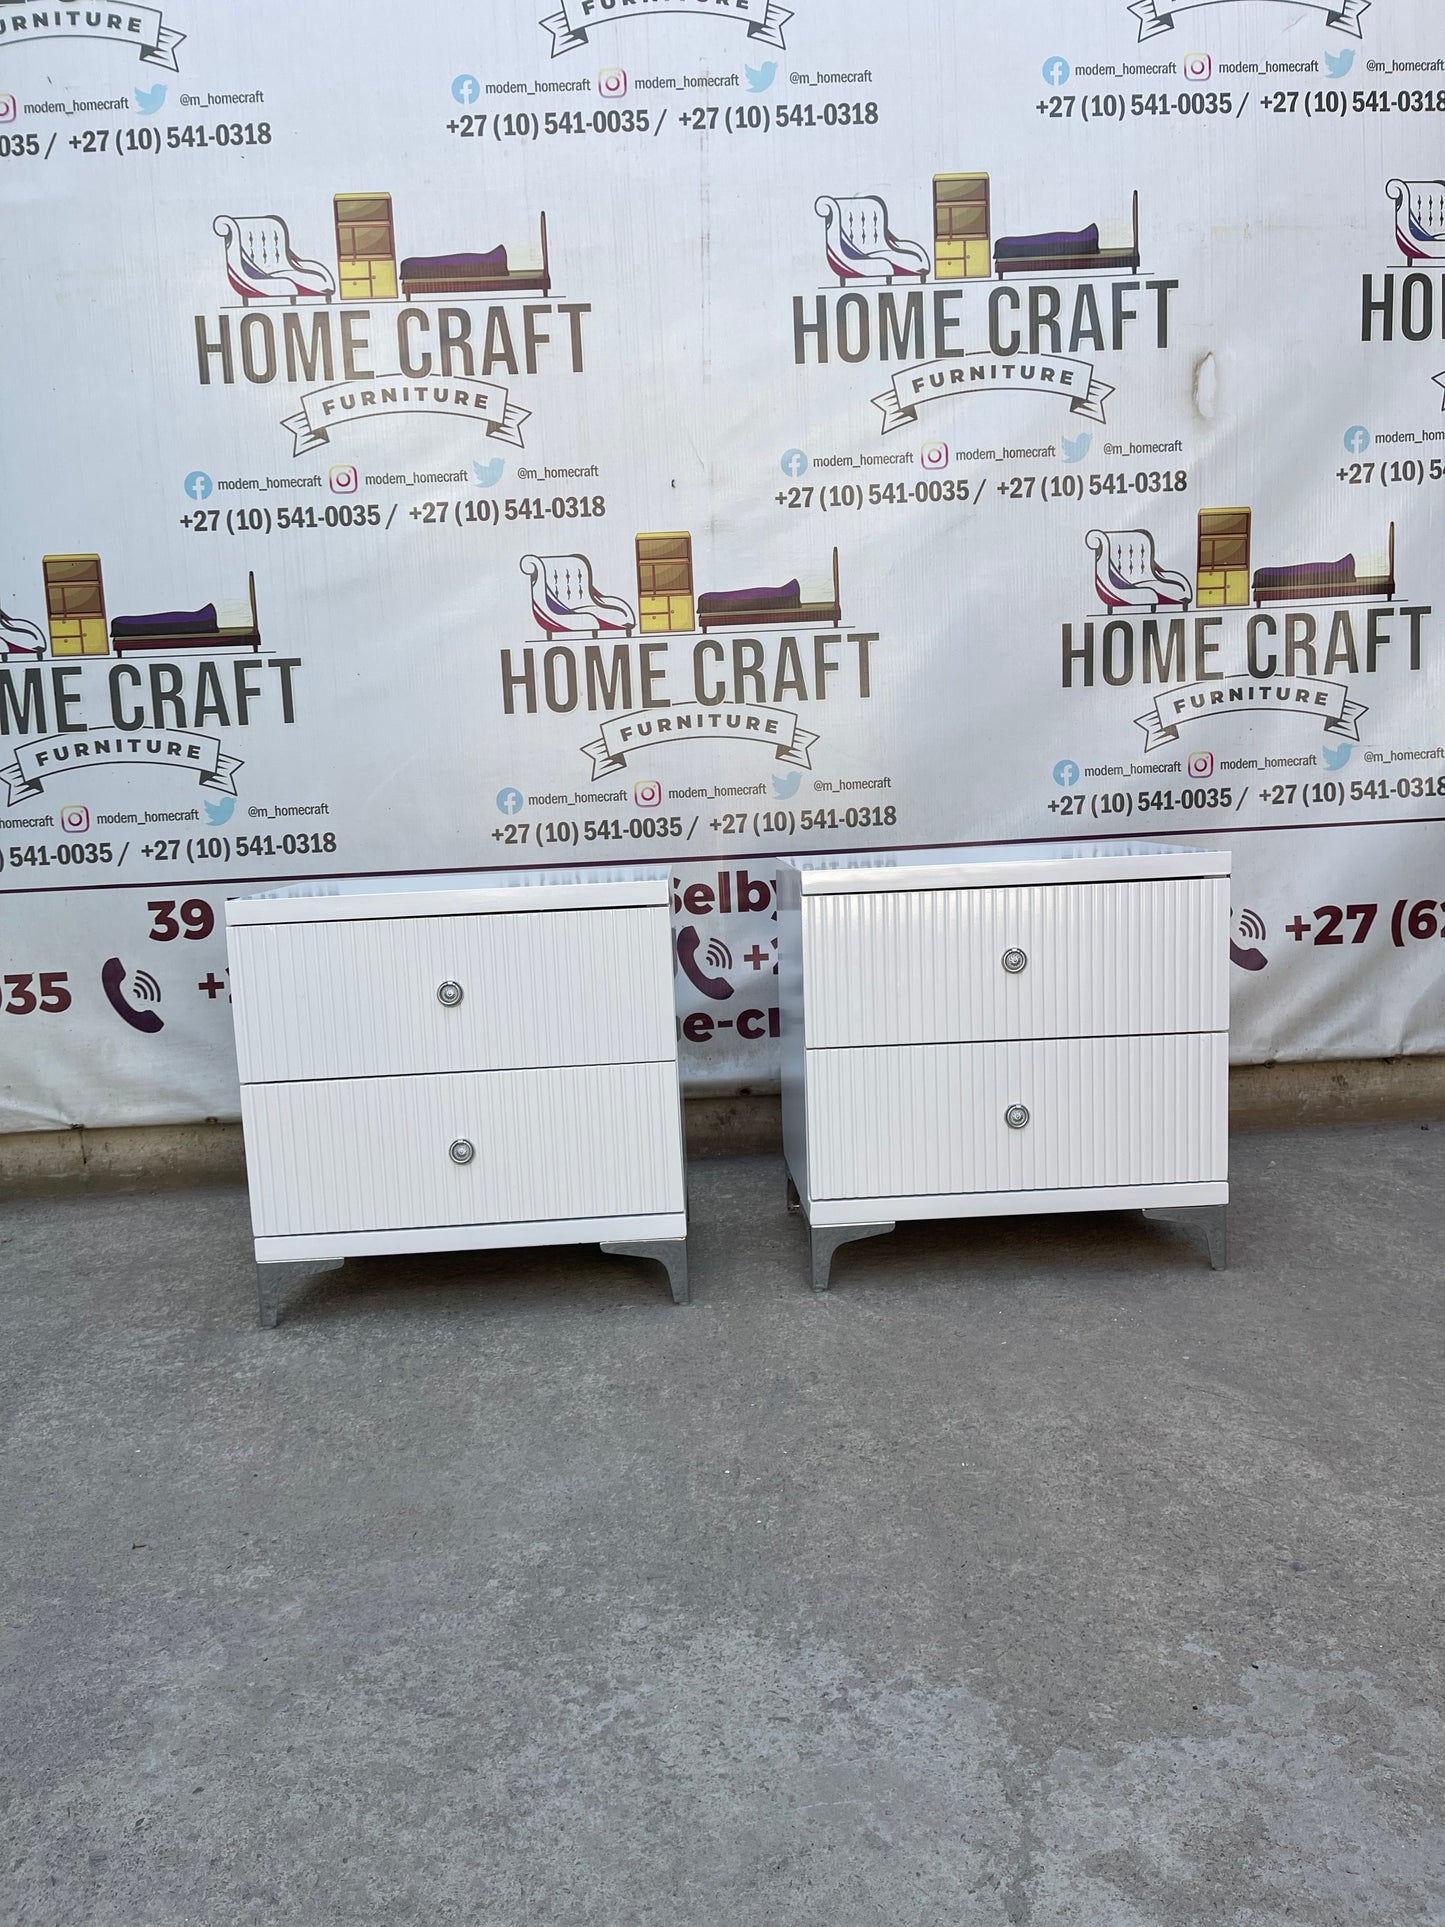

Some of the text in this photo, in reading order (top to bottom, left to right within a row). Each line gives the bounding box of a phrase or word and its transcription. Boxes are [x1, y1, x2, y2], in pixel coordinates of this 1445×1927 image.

[789, 70, 873, 86] @m_homecraft
[1366, 58, 1445, 74] @m_homecraft
[180, 90, 265, 108] @m_homecraft
[1036, 95, 1076, 118] +27
[1081, 94, 1125, 122] (10)
[1130, 92, 1232, 116] 541-0035
[1236, 92, 1250, 118] /
[1260, 91, 1299, 113] +27
[1305, 90, 1347, 117] (10)
[446, 102, 878, 141] +27 (10) 541-0035 / +27 (10) 541-0318
[44, 132, 57, 160] /
[69, 129, 109, 153] +27
[116, 127, 162, 156] (10)
[167, 122, 271, 149] 541-0318
[792, 279, 1179, 365] HOME CRAFT
[1361, 272, 1445, 341] HO
[194, 303, 591, 385] HOME CRAFT
[912, 364, 1075, 393] FURNITURE
[321, 386, 489, 416] FURNITURE
[1103, 439, 1183, 455] @m_homecraft
[517, 465, 599, 481] @m_homecraft
[1336, 458, 1445, 487] +27 (10) 5
[775, 470, 1188, 512] +27 (10) 541-0035 / +27 (10) 541-0318
[180, 495, 606, 535] +27 (10) 541-0035 / +27 (10) 541-0318
[1061, 605, 1432, 688] HOME CRAFT
[500, 632, 880, 715] HOME CRAFT
[108, 657, 302, 731] CRAFT
[1173, 686, 1329, 715] FURNITURE
[619, 714, 780, 742] FURNITURE
[35, 739, 201, 767] FURNITURE
[1363, 747, 1445, 764] @m_homecraft
[813, 777, 891, 793] @m_homecraft
[1047, 795, 1086, 817] +27
[1091, 792, 1133, 818] (10)
[1137, 787, 1233, 811] 541-0035
[1235, 786, 1249, 811] /
[1258, 784, 1298, 805] +27
[1302, 781, 1345, 806] (10)
[247, 803, 330, 820] @m_homecraft
[491, 805, 897, 848] +27 (10) 541-0035 / +27 (10) 541-0318
[9, 842, 113, 867] 541-0035
[117, 841, 130, 867] /
[141, 839, 181, 863] +27
[186, 837, 231, 865] (10)
[235, 832, 337, 857] 541-0318
[147, 898, 215, 942] 39
[1285, 904, 1378, 946] +27
[0, 971, 72, 1015] 35
